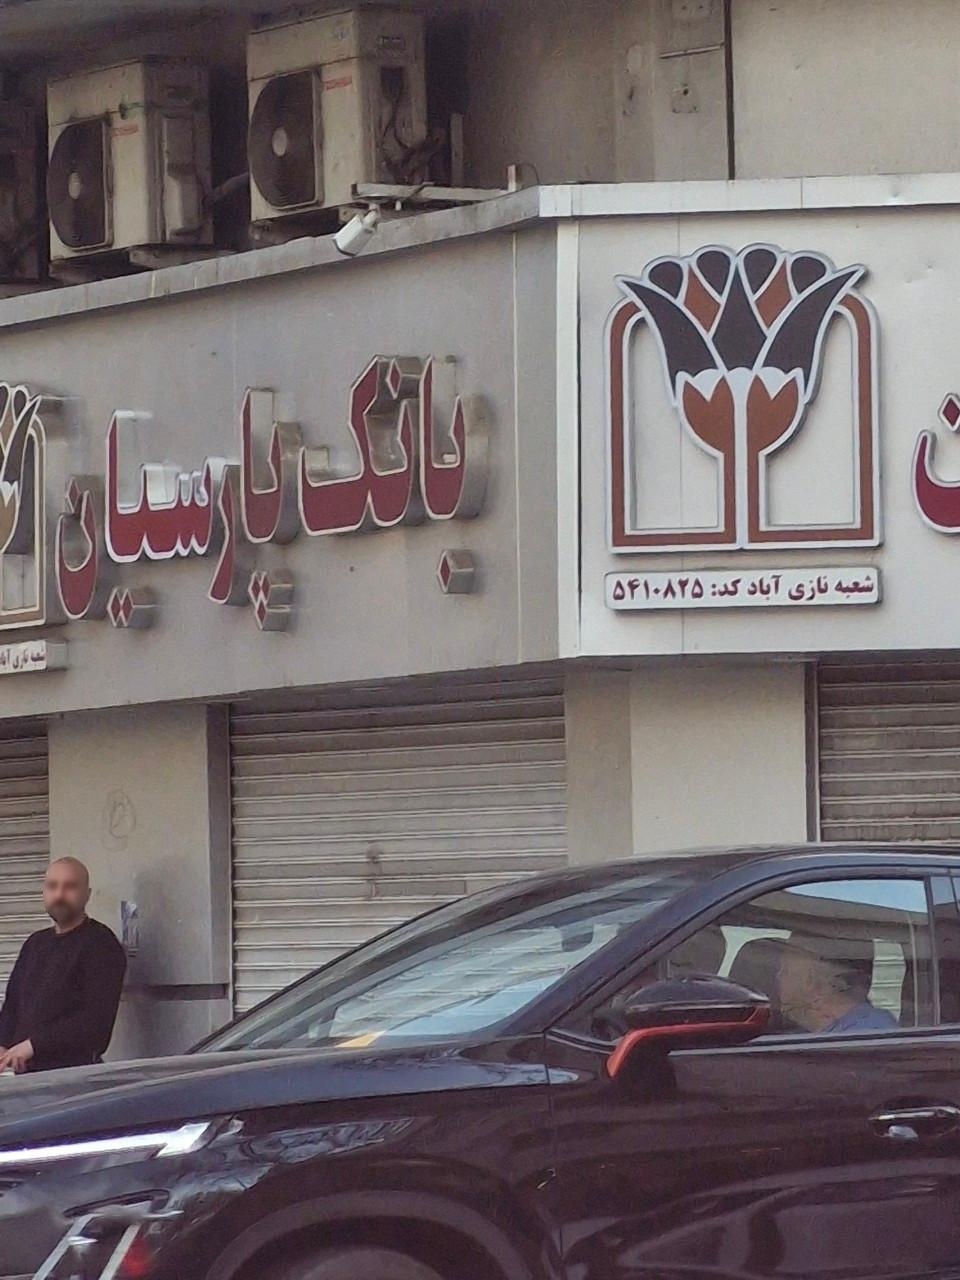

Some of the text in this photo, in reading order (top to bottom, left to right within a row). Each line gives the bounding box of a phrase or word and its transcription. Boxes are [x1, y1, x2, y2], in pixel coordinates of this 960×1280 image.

[55, 354, 466, 631] بانک پارسیان
[747, 574, 782, 601] آباد
[834, 575, 874, 600] شعبه
